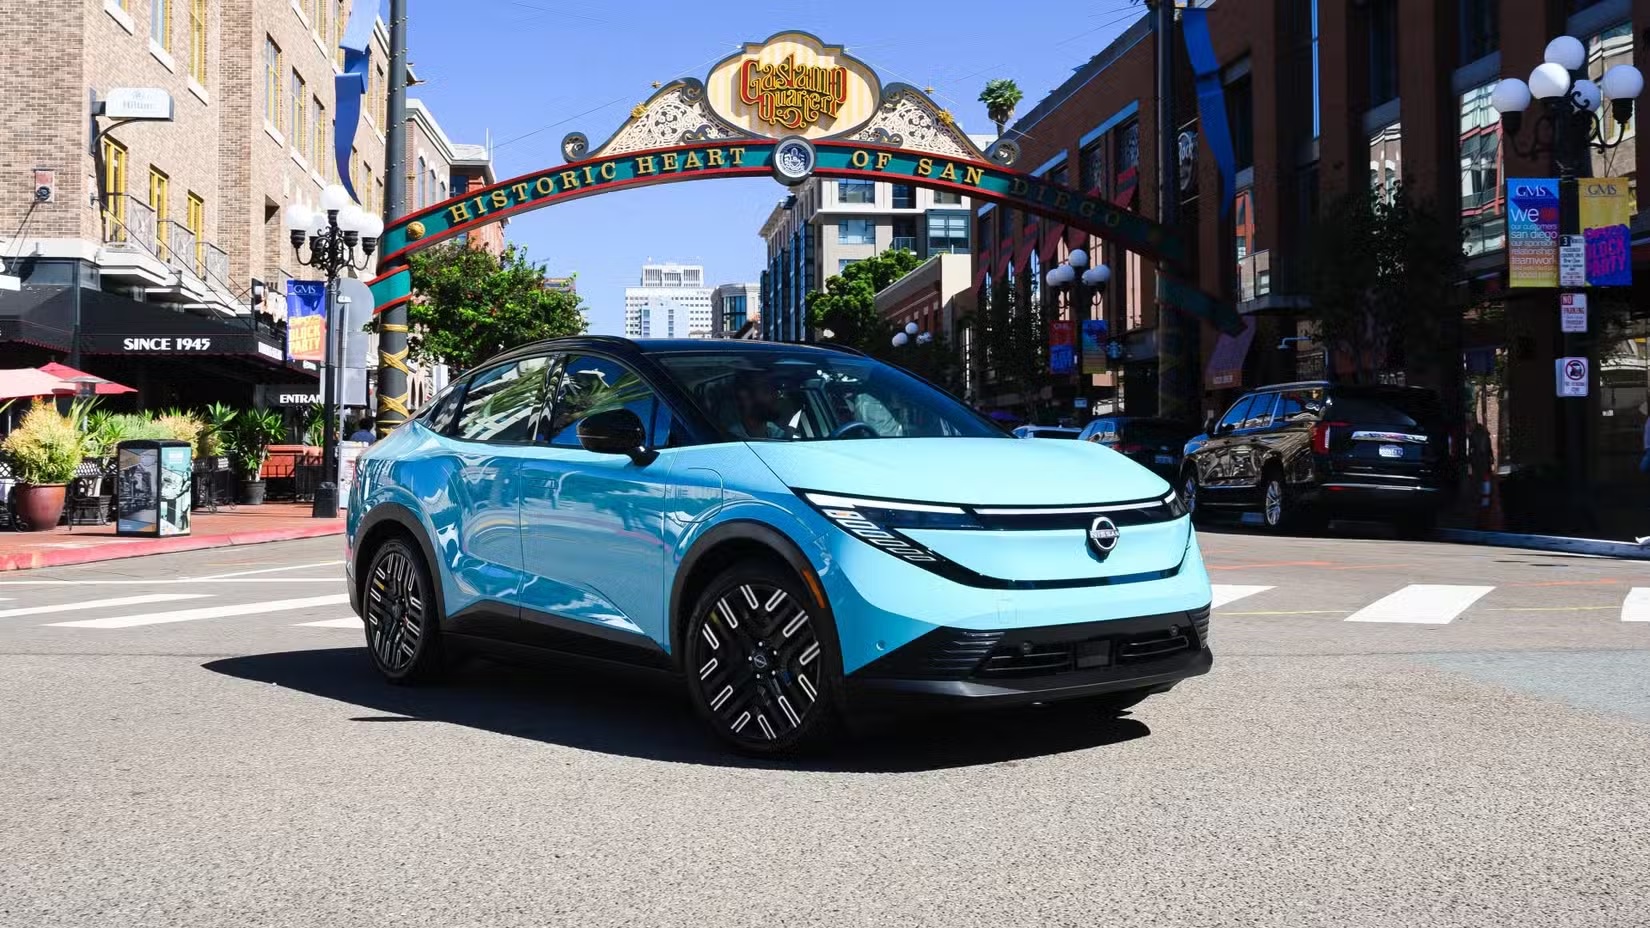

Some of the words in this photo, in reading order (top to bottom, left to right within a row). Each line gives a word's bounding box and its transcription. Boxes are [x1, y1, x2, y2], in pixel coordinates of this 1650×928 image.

[740, 53, 848, 104] Gaslamp
[758, 90, 839, 129] Quarter
[448, 162, 616, 223] HISTORIC
[636, 147, 745, 175] HEART
[852, 150, 892, 170] OF
[917, 158, 985, 186] SAN
[1010, 177, 1121, 228] DIEGO
[1515, 185, 1546, 197] GMS
[1587, 184, 1617, 196] GMS
[1510, 208, 1539, 223] we
[1510, 231, 1529, 239] san
[1530, 229, 1558, 241] diego
[1562, 236, 1568, 246] 3
[293, 284, 316, 294] GMS
[1562, 295, 1572, 305] NO
[123, 337, 171, 351] SINCE
[175, 337, 211, 351] 1945
